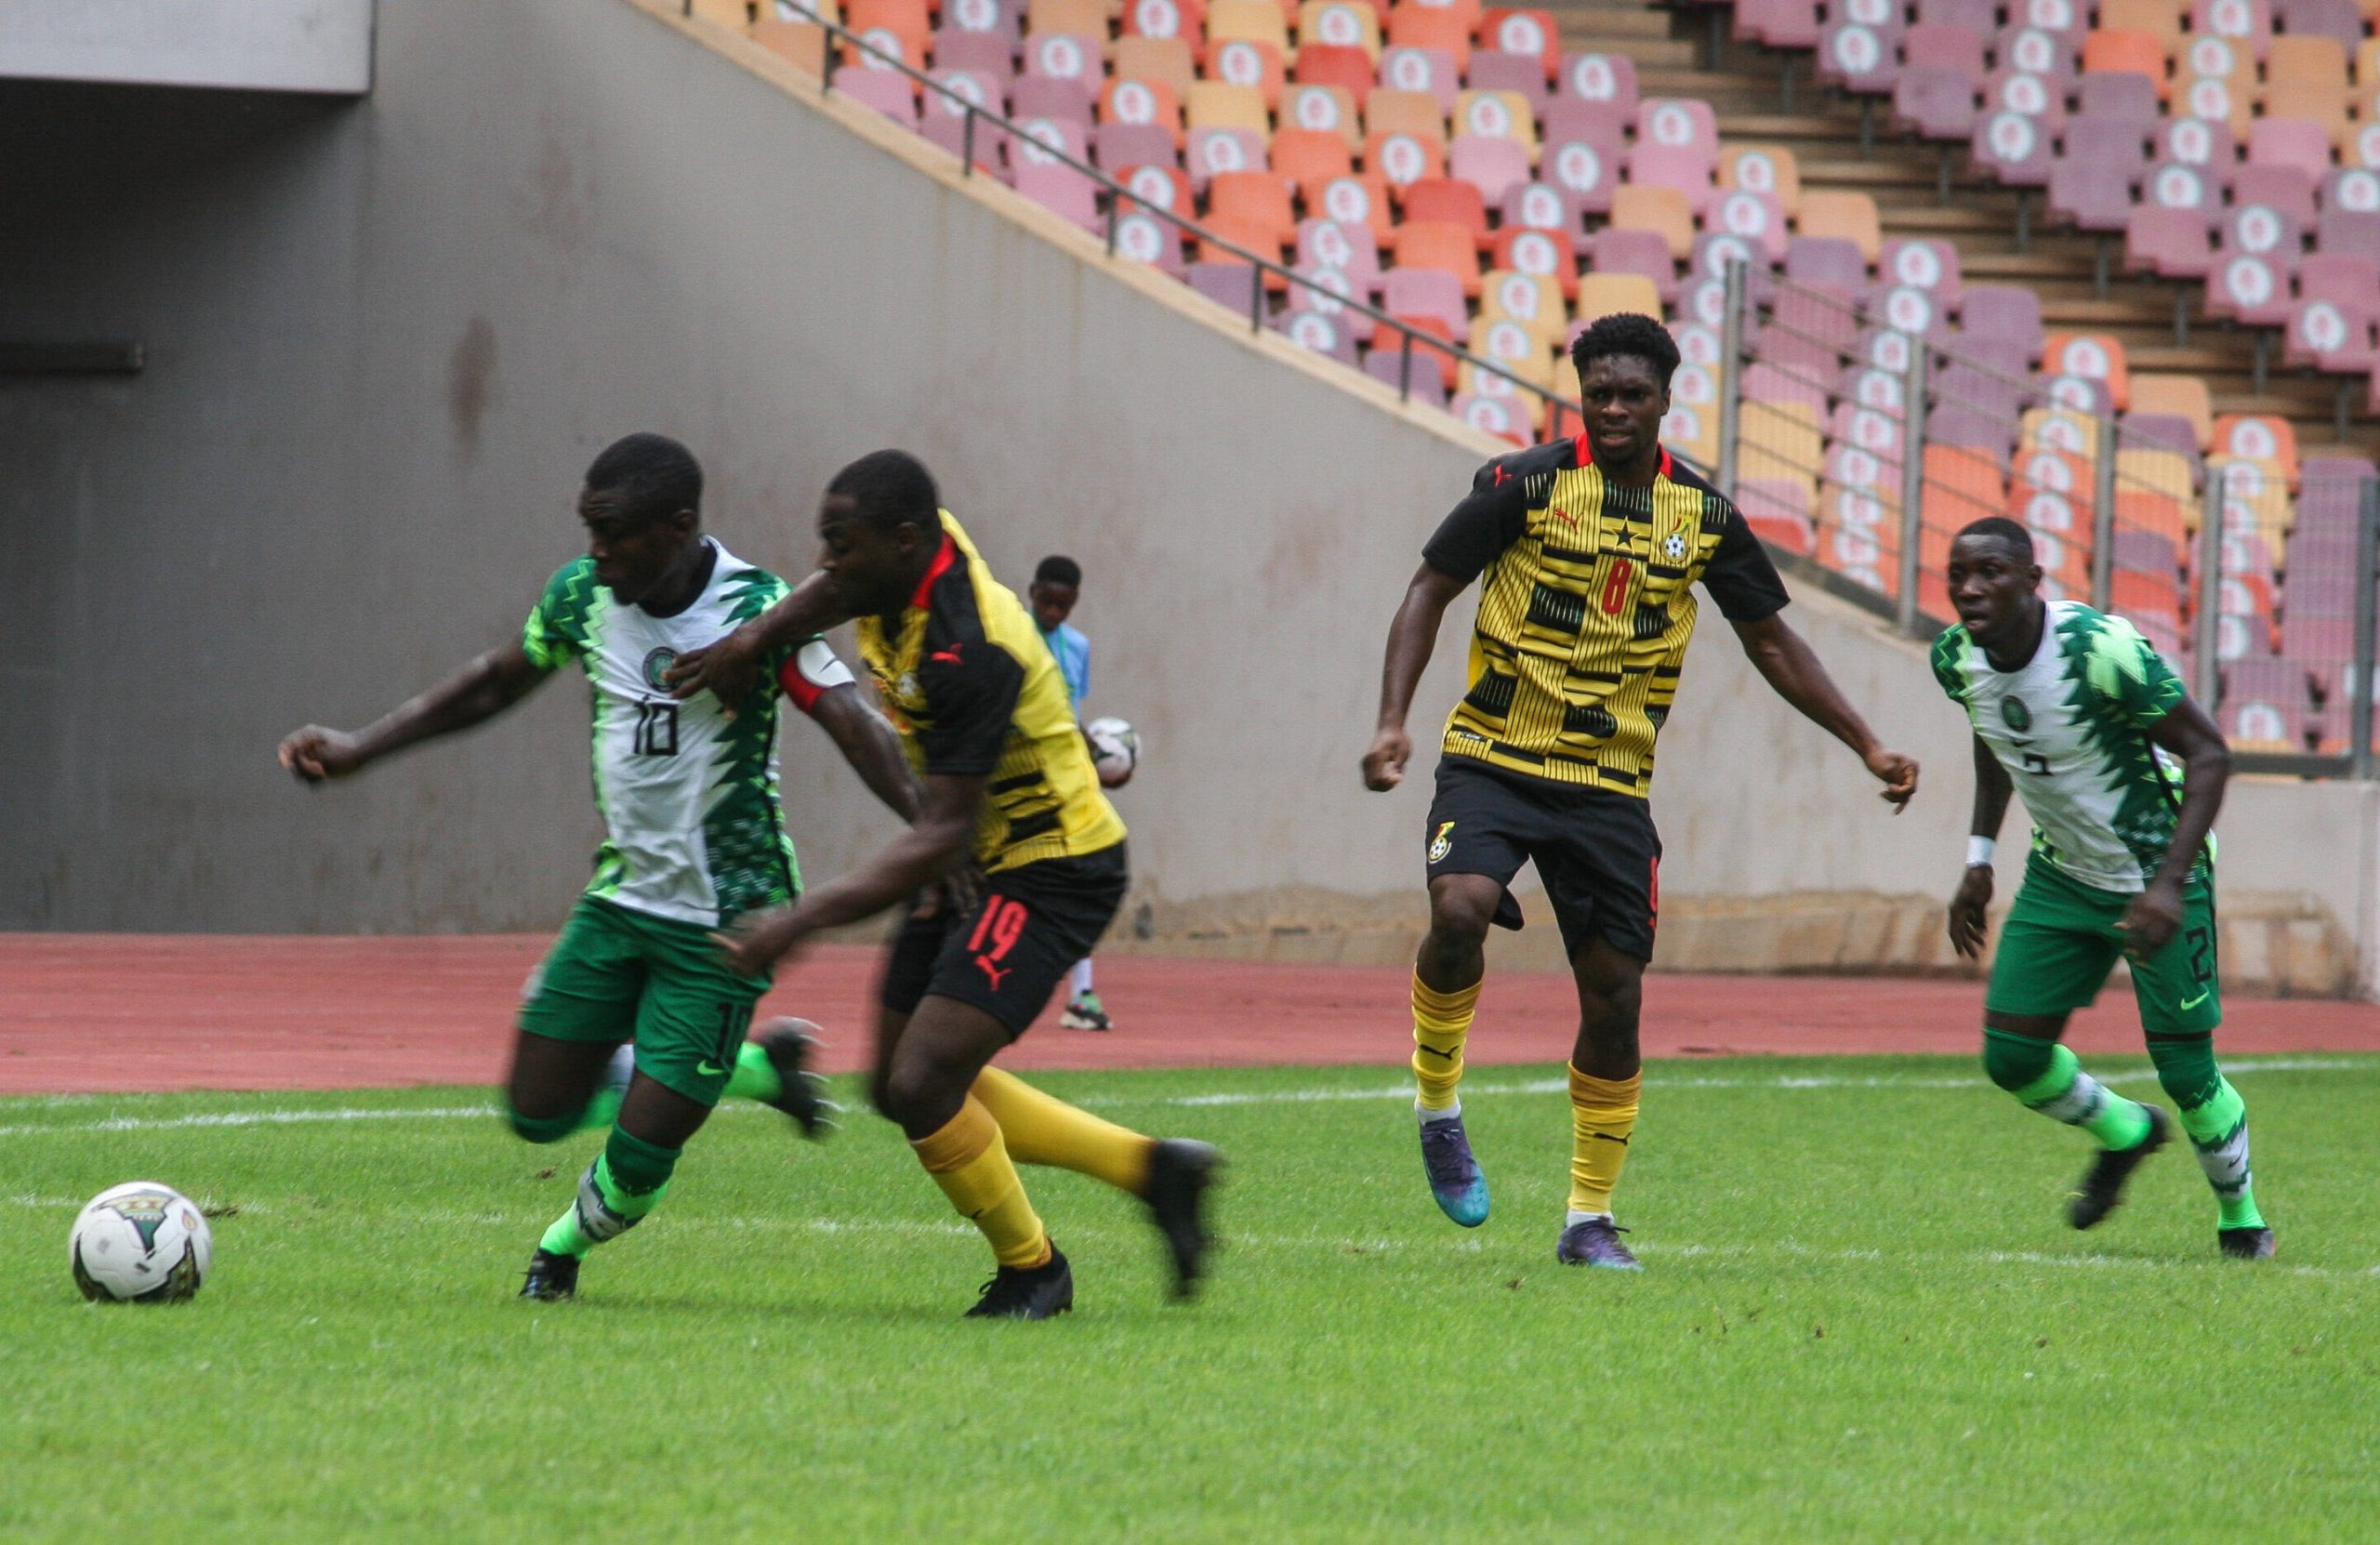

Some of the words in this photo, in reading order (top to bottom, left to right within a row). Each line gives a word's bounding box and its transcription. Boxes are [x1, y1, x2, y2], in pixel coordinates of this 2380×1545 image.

[1603, 559, 1632, 614] 8
[633, 694, 679, 756] 10
[968, 894, 1027, 961] 19
[2186, 926, 2212, 982] 2
